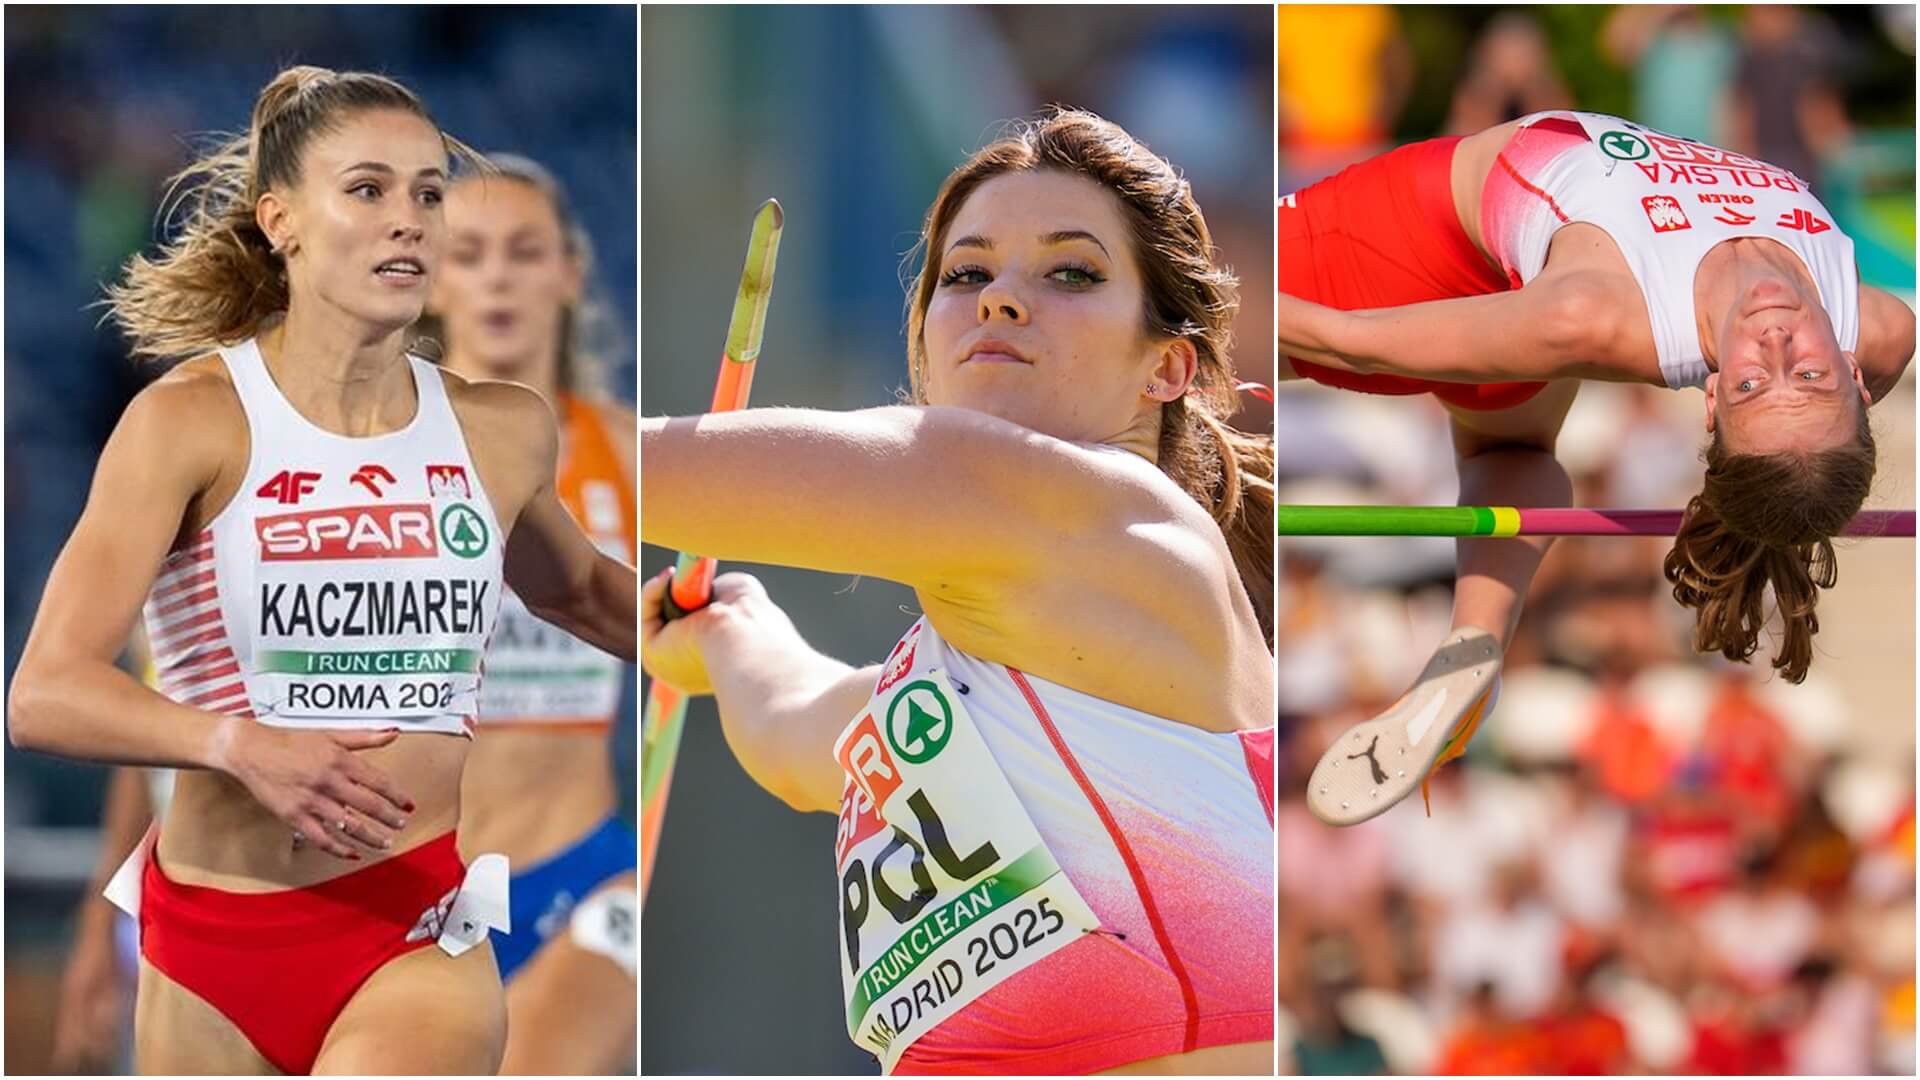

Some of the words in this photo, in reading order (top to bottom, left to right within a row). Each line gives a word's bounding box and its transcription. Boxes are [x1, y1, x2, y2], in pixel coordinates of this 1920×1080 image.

[1649, 139, 1768, 168] PAR
[1635, 162, 1799, 193] POLSKA
[1697, 193, 1755, 205] ORLEN
[1776, 208, 1831, 234] 4F
[256, 470, 323, 504] 4F
[262, 512, 434, 554] SPAR
[259, 579, 490, 638] KACZMAREK
[306, 654, 314, 672] I
[318, 654, 371, 672] RUN
[288, 682, 390, 710] ROMA
[398, 682, 456, 709] 202
[838, 733, 893, 854] SPR
[842, 787, 1001, 976] POL
[861, 976, 872, 1001] I
[869, 941, 915, 994] RUN
[867, 958, 964, 1050] MADRID
[967, 896, 1064, 978] 2025
